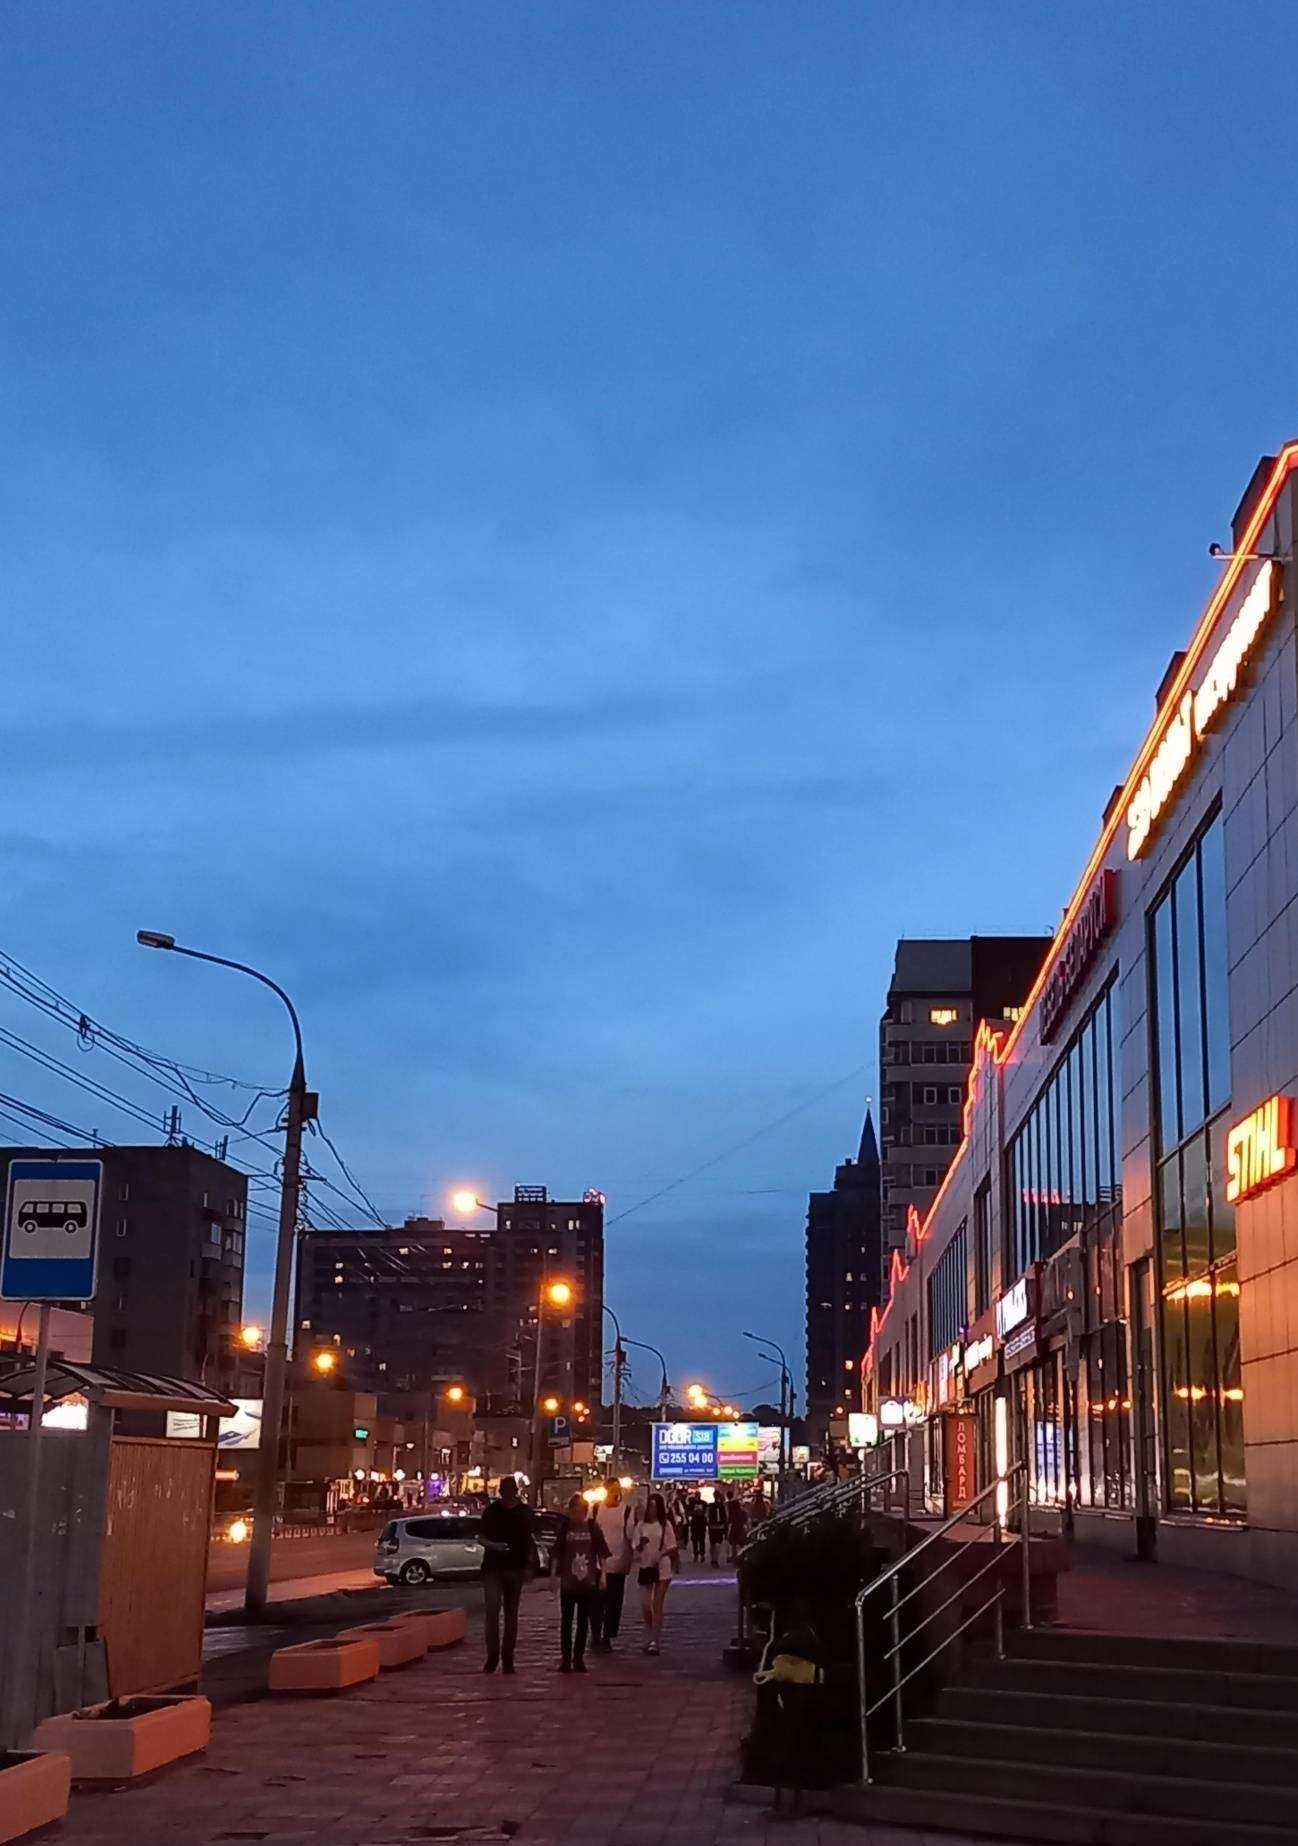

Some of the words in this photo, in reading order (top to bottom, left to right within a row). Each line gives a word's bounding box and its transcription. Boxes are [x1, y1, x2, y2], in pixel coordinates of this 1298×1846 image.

[1227, 1096, 1286, 1202] STIHL
[670, 1452, 687, 1464] 255
[688, 1452, 700, 1464] 04
[957, 1422, 967, 1499] ЛОМБАРД
